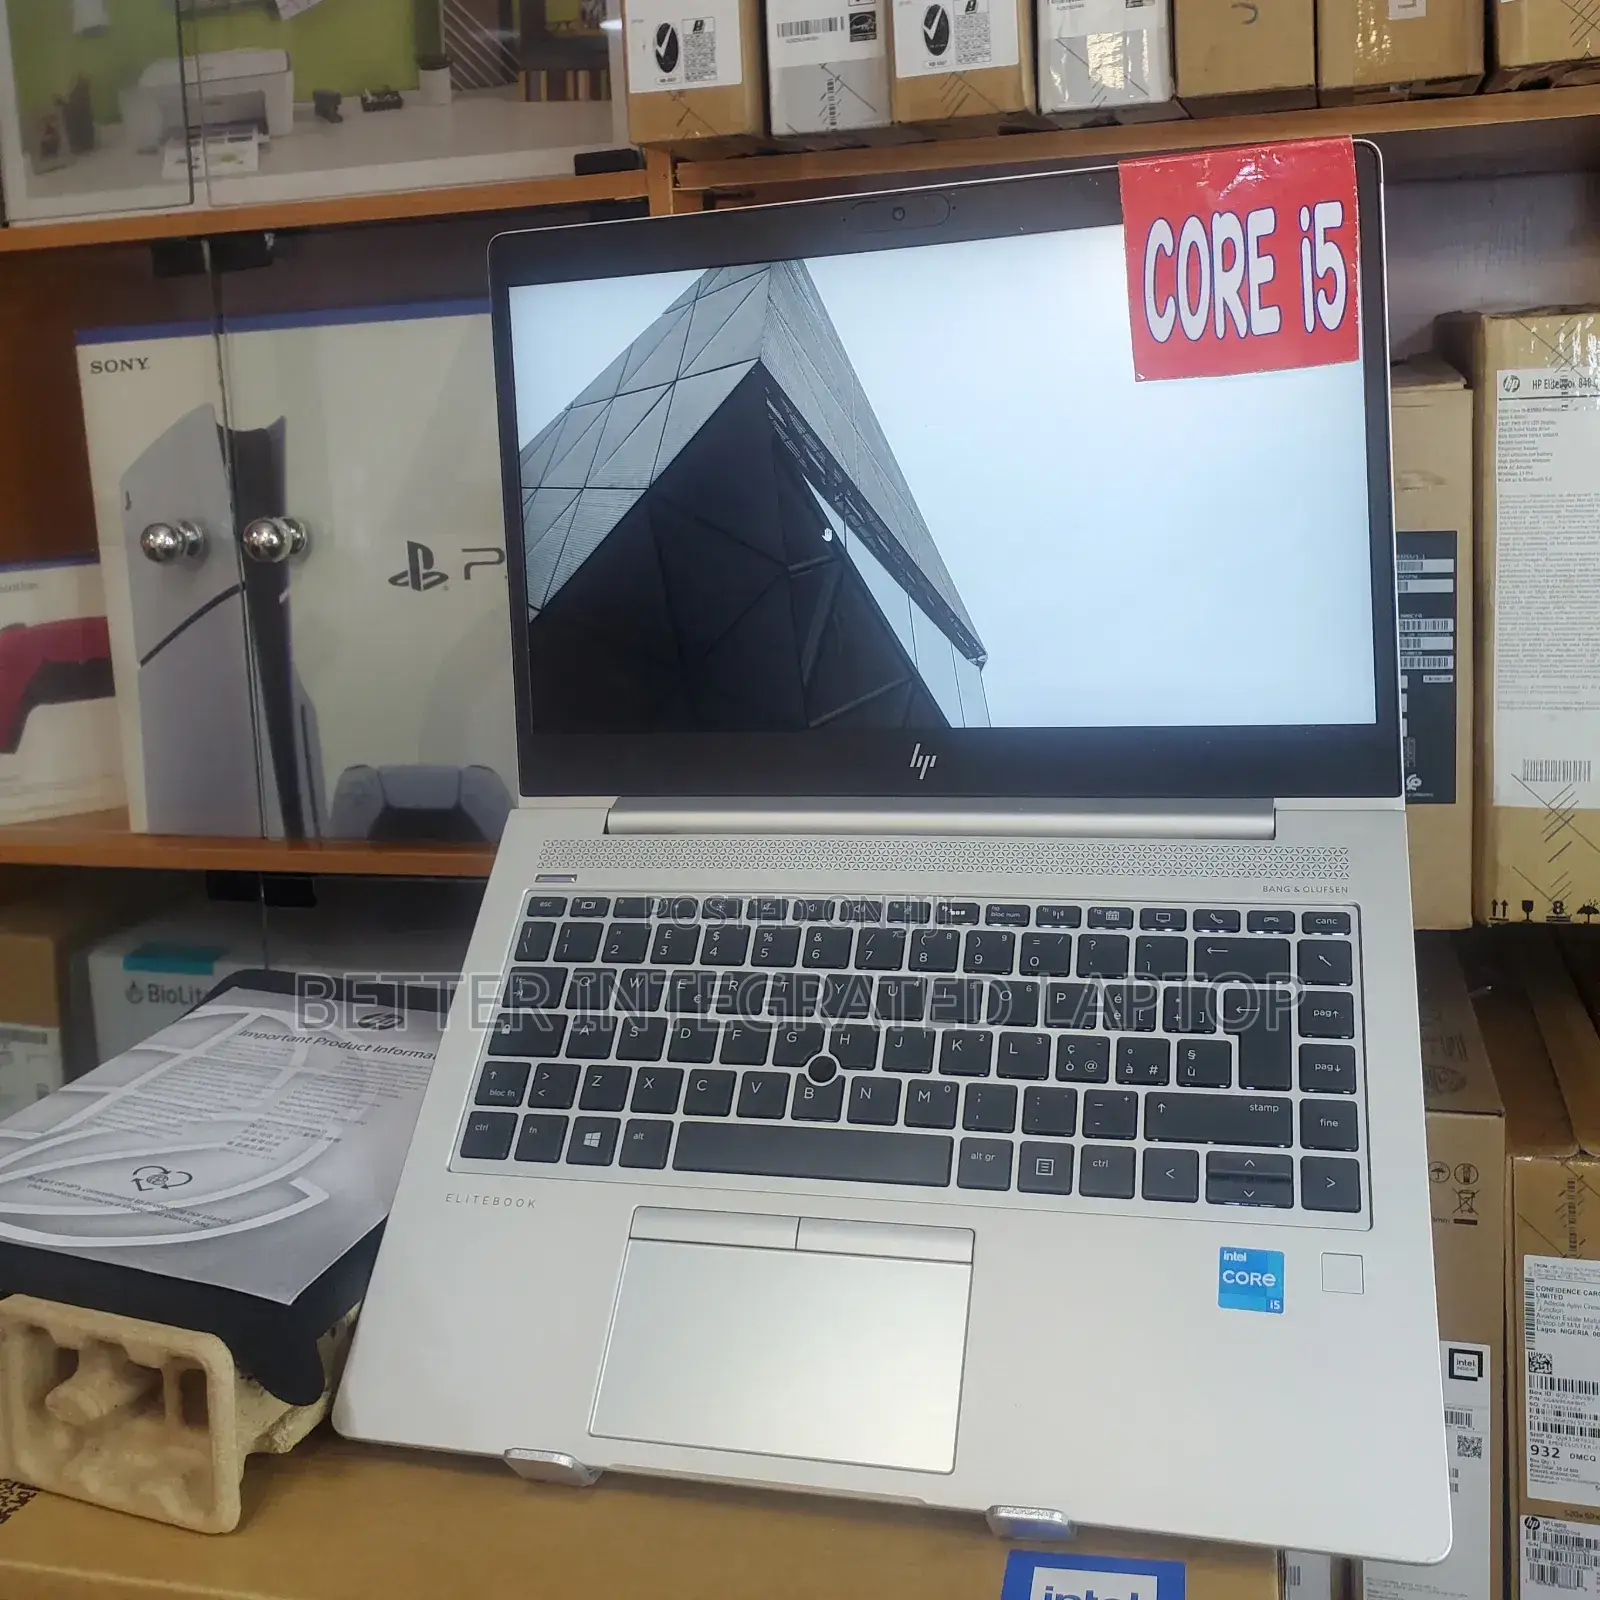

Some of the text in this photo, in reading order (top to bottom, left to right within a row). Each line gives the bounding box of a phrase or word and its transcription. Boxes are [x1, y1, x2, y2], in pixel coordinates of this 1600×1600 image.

[1143, 200, 1348, 344] CORE i5
[90, 357, 149, 374] SONY
[1532, 379, 1542, 390] HP
[908, 742, 937, 780] hp
[1262, 885, 1348, 894] BANG & OLUFSEN
[990, 910, 1006, 918] bloc
[1315, 917, 1338, 925] canc
[664, 929, 673, 939] £
[712, 930, 721, 941] $
[763, 932, 773, 943] %
[813, 932, 824, 943] &
[946, 932, 952, 940] 8
[1001, 934, 1008, 942] 9
[974, 936, 981, 948] )
[1089, 939, 1097, 950] ?
[563, 944, 568, 954] 1
[610, 944, 619, 954] 2
[660, 945, 669, 956] 3
[709, 946, 718, 956] 4
[760, 948, 769, 958] 5
[811, 949, 821, 959] 6
[865, 951, 874, 961] 7
[919, 952, 928, 963] 8
[974, 954, 983, 965] 9
[579, 976, 591, 987] Q
[629, 977, 644, 988] W
[677, 978, 687, 990] E
[728, 980, 739, 991] R
[780, 981, 790, 993] T
[834, 983, 845, 995] Y
[887, 985, 899, 997] U
[1025, 984, 1032, 992] 6
[693, 993, 703, 1004] €
[1055, 992, 1067, 1004] P
[578, 1025, 591, 1036] A
[628, 1026, 640, 1038] S
[679, 1028, 692, 1039] D
[731, 1029, 742, 1041] F
[238, 1029, 313, 1045] Important
[313, 1037, 372, 1053] Product
[786, 1031, 797, 1042] G
[839, 1033, 851, 1045] H
[978, 1034, 985, 1042] 2
[1036, 1037, 1043, 1045] 3
[894, 1037, 904, 1048] J
[951, 1039, 964, 1051] K
[1009, 1042, 1019, 1054] L
[1067, 1044, 1076, 1055] ç
[1084, 1060, 1098, 1072] @
[1125, 1063, 1134, 1075] à
[1148, 1064, 1159, 1076] #
[591, 1074, 603, 1087] Z
[642, 1077, 655, 1089] X
[696, 1079, 709, 1092] C
[489, 1088, 516, 1098] bloc fn
[751, 1081, 763, 1094] V
[803, 1086, 815, 1100] B
[859, 1087, 872, 1100] N
[917, 1090, 932, 1103] M
[1249, 1102, 1280, 1113] stamp
[474, 1123, 489, 1133] ctrl
[1319, 1118, 1339, 1128] fine
[528, 1125, 538, 1135] fn
[632, 1131, 645, 1141] alt
[970, 1152, 996, 1162] alt gr
[1092, 1159, 1109, 1169] ctrl
[445, 1193, 537, 1208] ELITEBOOK
[1223, 1250, 1247, 1262] intel
[1535, 1285, 1581, 1296] CONFIDENCE
[1535, 1292, 1564, 1301] LIMITED
[1269, 1299, 1281, 1310] i5
[1536, 1326, 1589, 1337] Lagos NIGERIA
[1530, 1444, 1596, 1462] 932 DMCQ
[1524, 1516, 1540, 1530] hp
